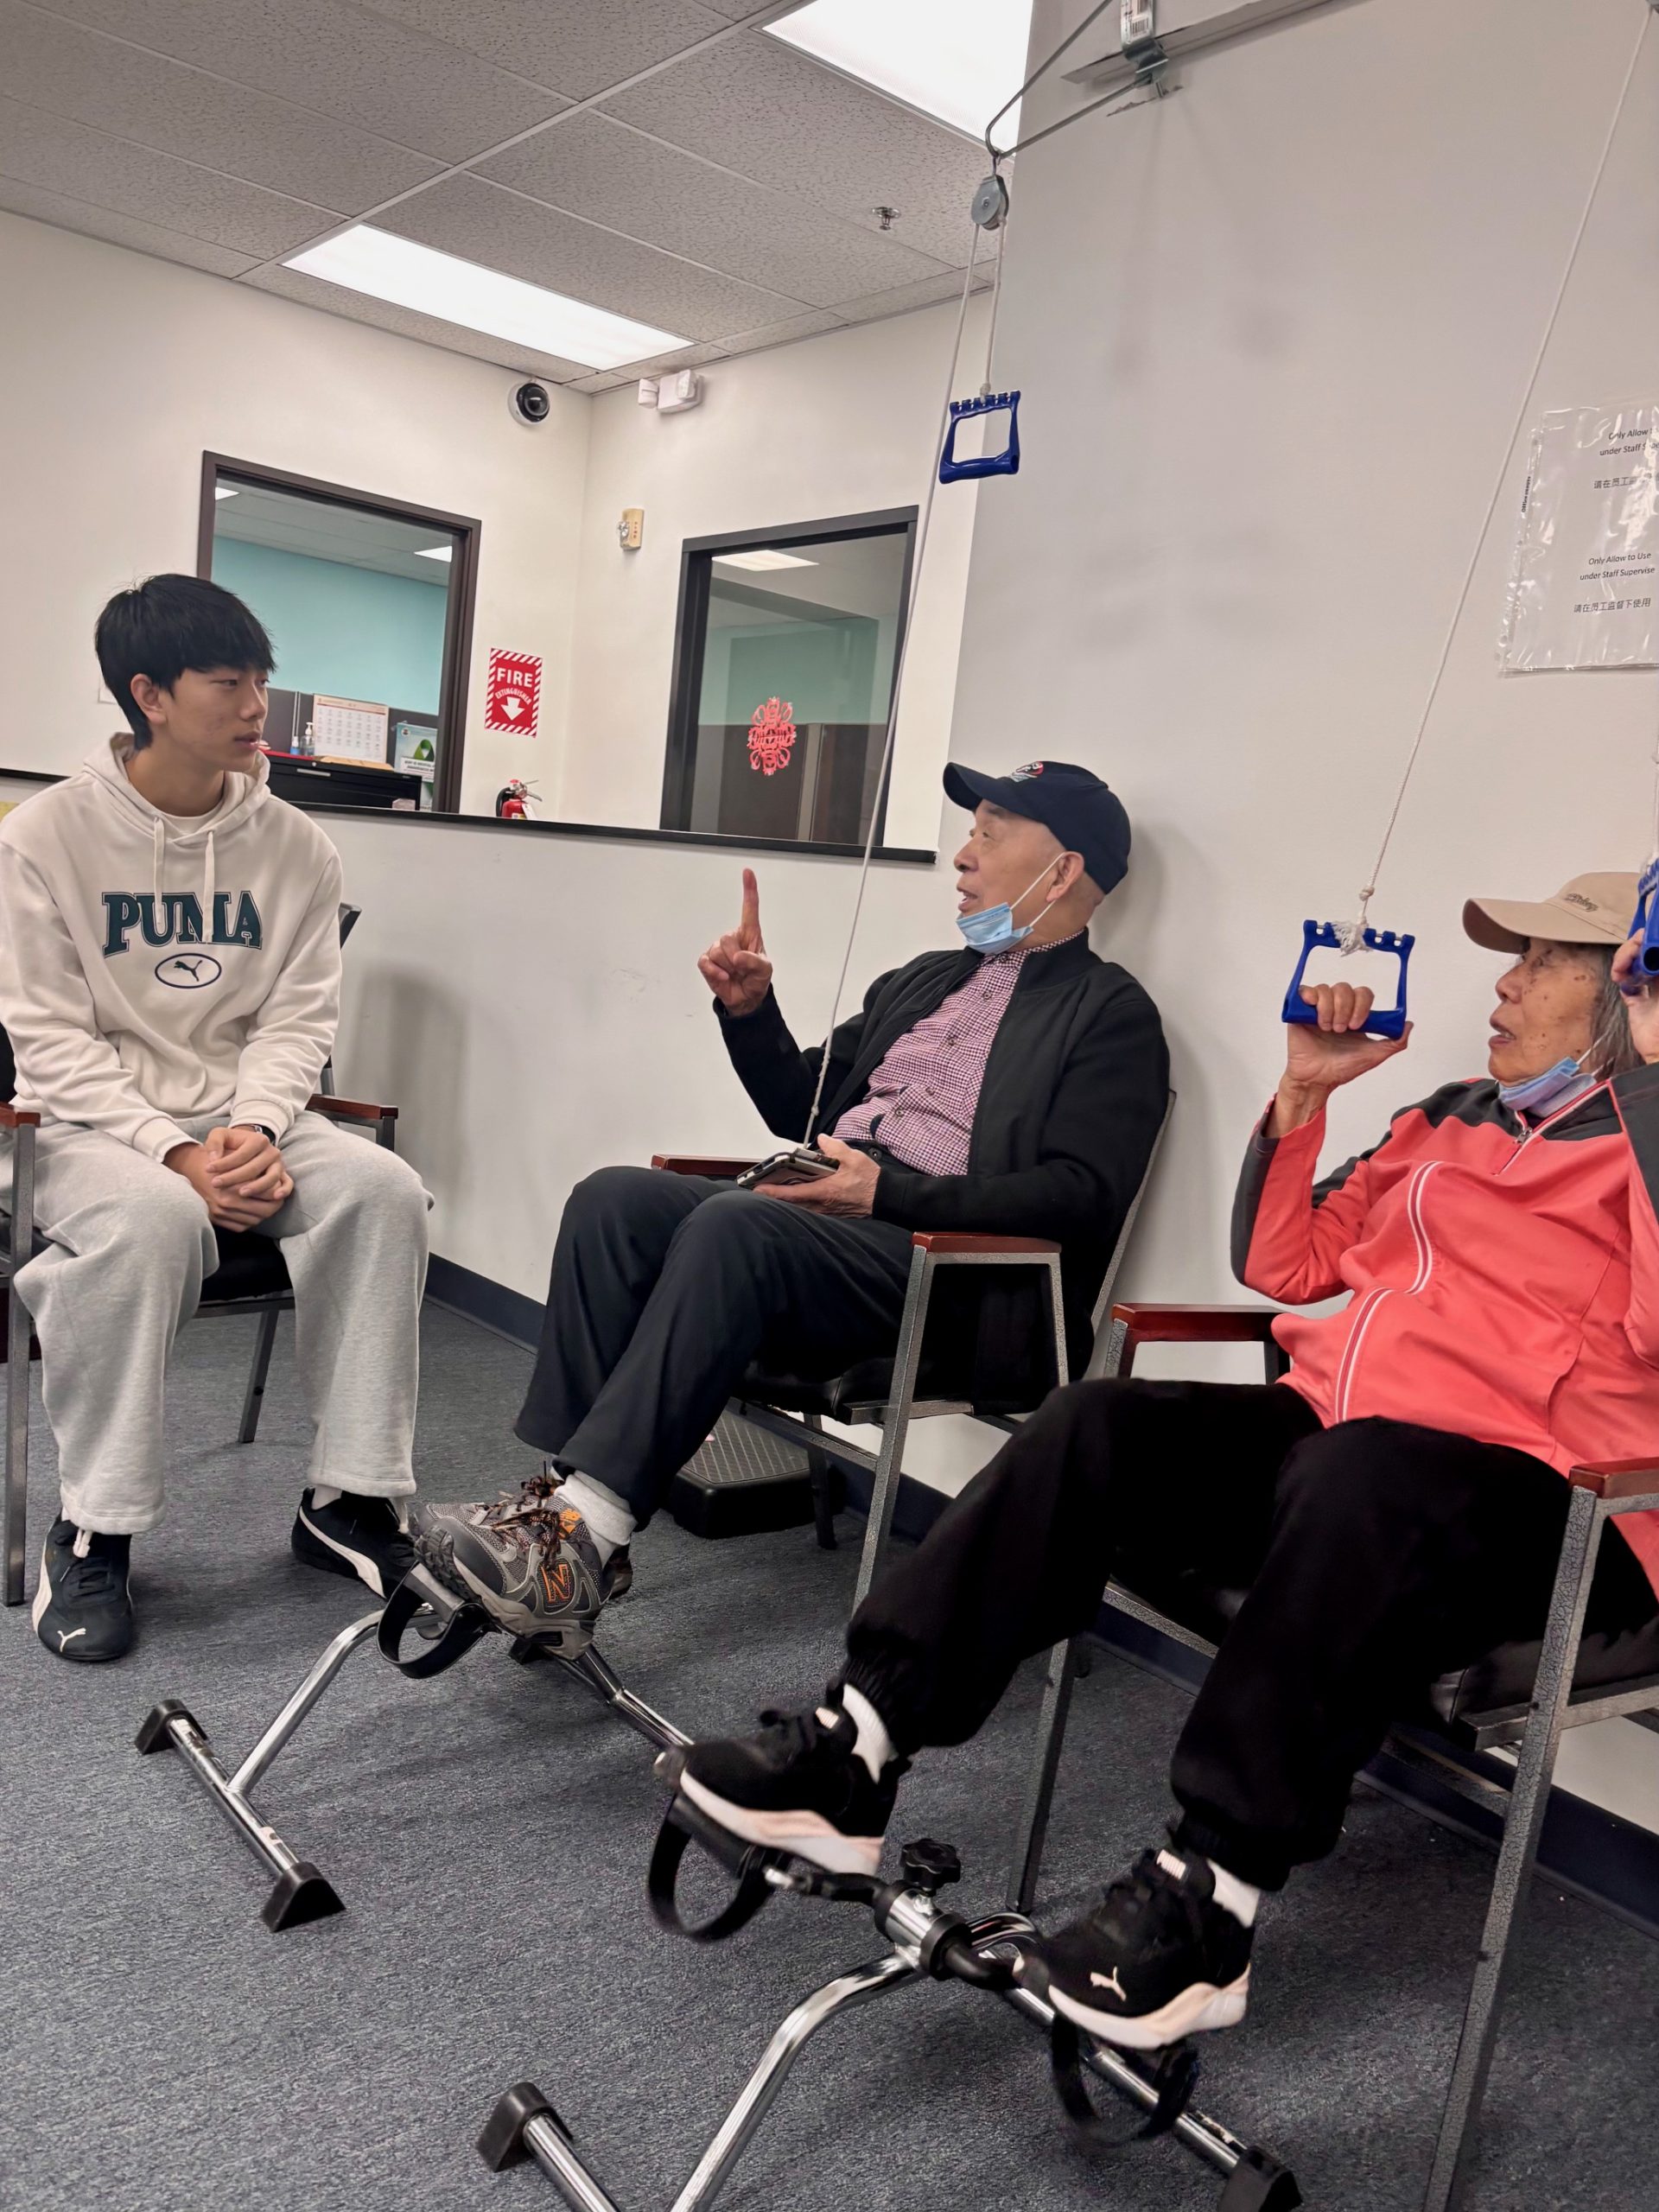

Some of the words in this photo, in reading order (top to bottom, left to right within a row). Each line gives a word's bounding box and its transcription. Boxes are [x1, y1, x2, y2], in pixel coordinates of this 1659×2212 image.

[1627, 429, 1648, 438] Allow
[1599, 447, 1622, 456] under
[1623, 443, 1641, 453] Staff
[1580, 572, 1601, 581] under
[1602, 569, 1619, 578] Staff
[1620, 567, 1656, 577] Supervise
[1573, 598, 1651, 613] 请在员工监督下使用
[497, 667, 533, 688] FIRE
[494, 688, 532, 704] EXTINGUISHER
[102, 891, 263, 959] PUMA
